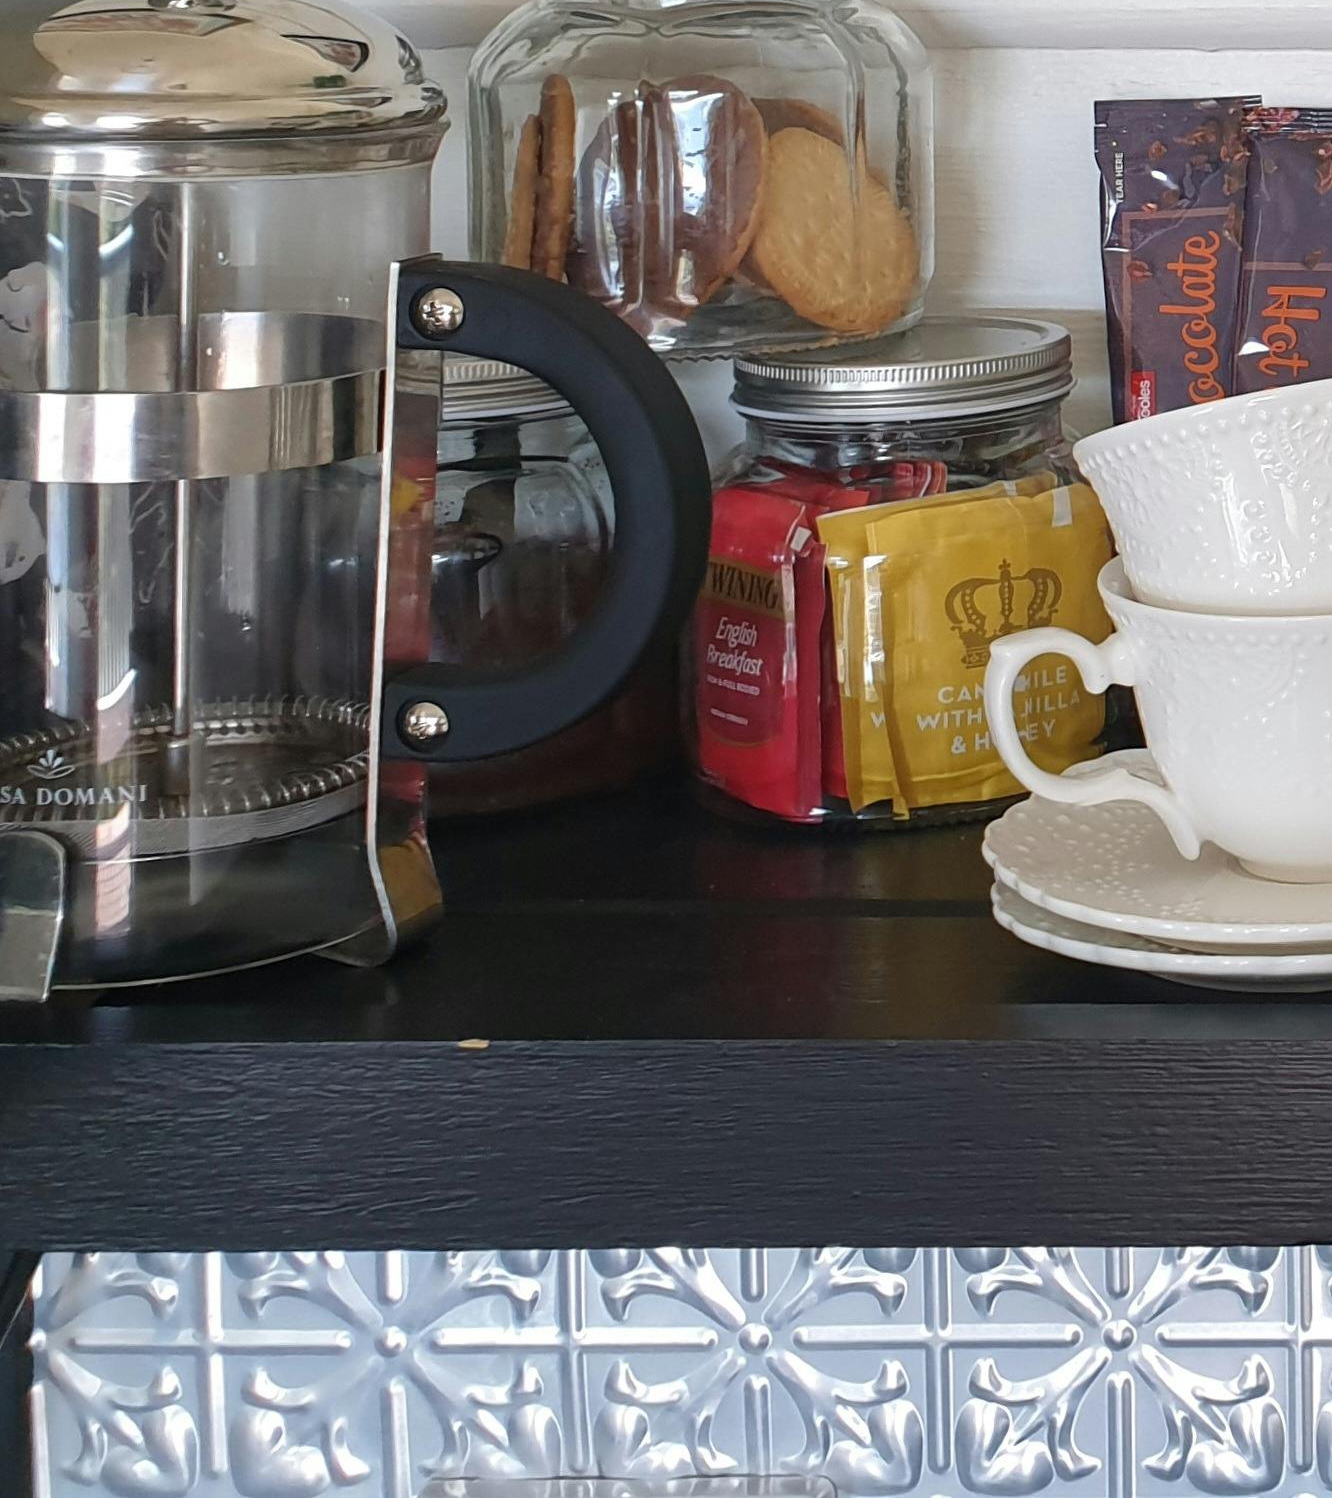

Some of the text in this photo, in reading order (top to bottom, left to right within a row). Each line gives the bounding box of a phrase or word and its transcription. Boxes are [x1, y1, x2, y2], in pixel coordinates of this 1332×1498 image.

[1114, 152, 1124, 177] HERE
[1158, 230, 1225, 404] ocolate
[1258, 286, 1327, 377] Hot
[715, 617, 758, 649] English
[707, 644, 763, 676] Breakfast
[917, 706, 982, 731] WITH
[952, 735, 967, 754] &
[36, 784, 147, 806] DOMANI
